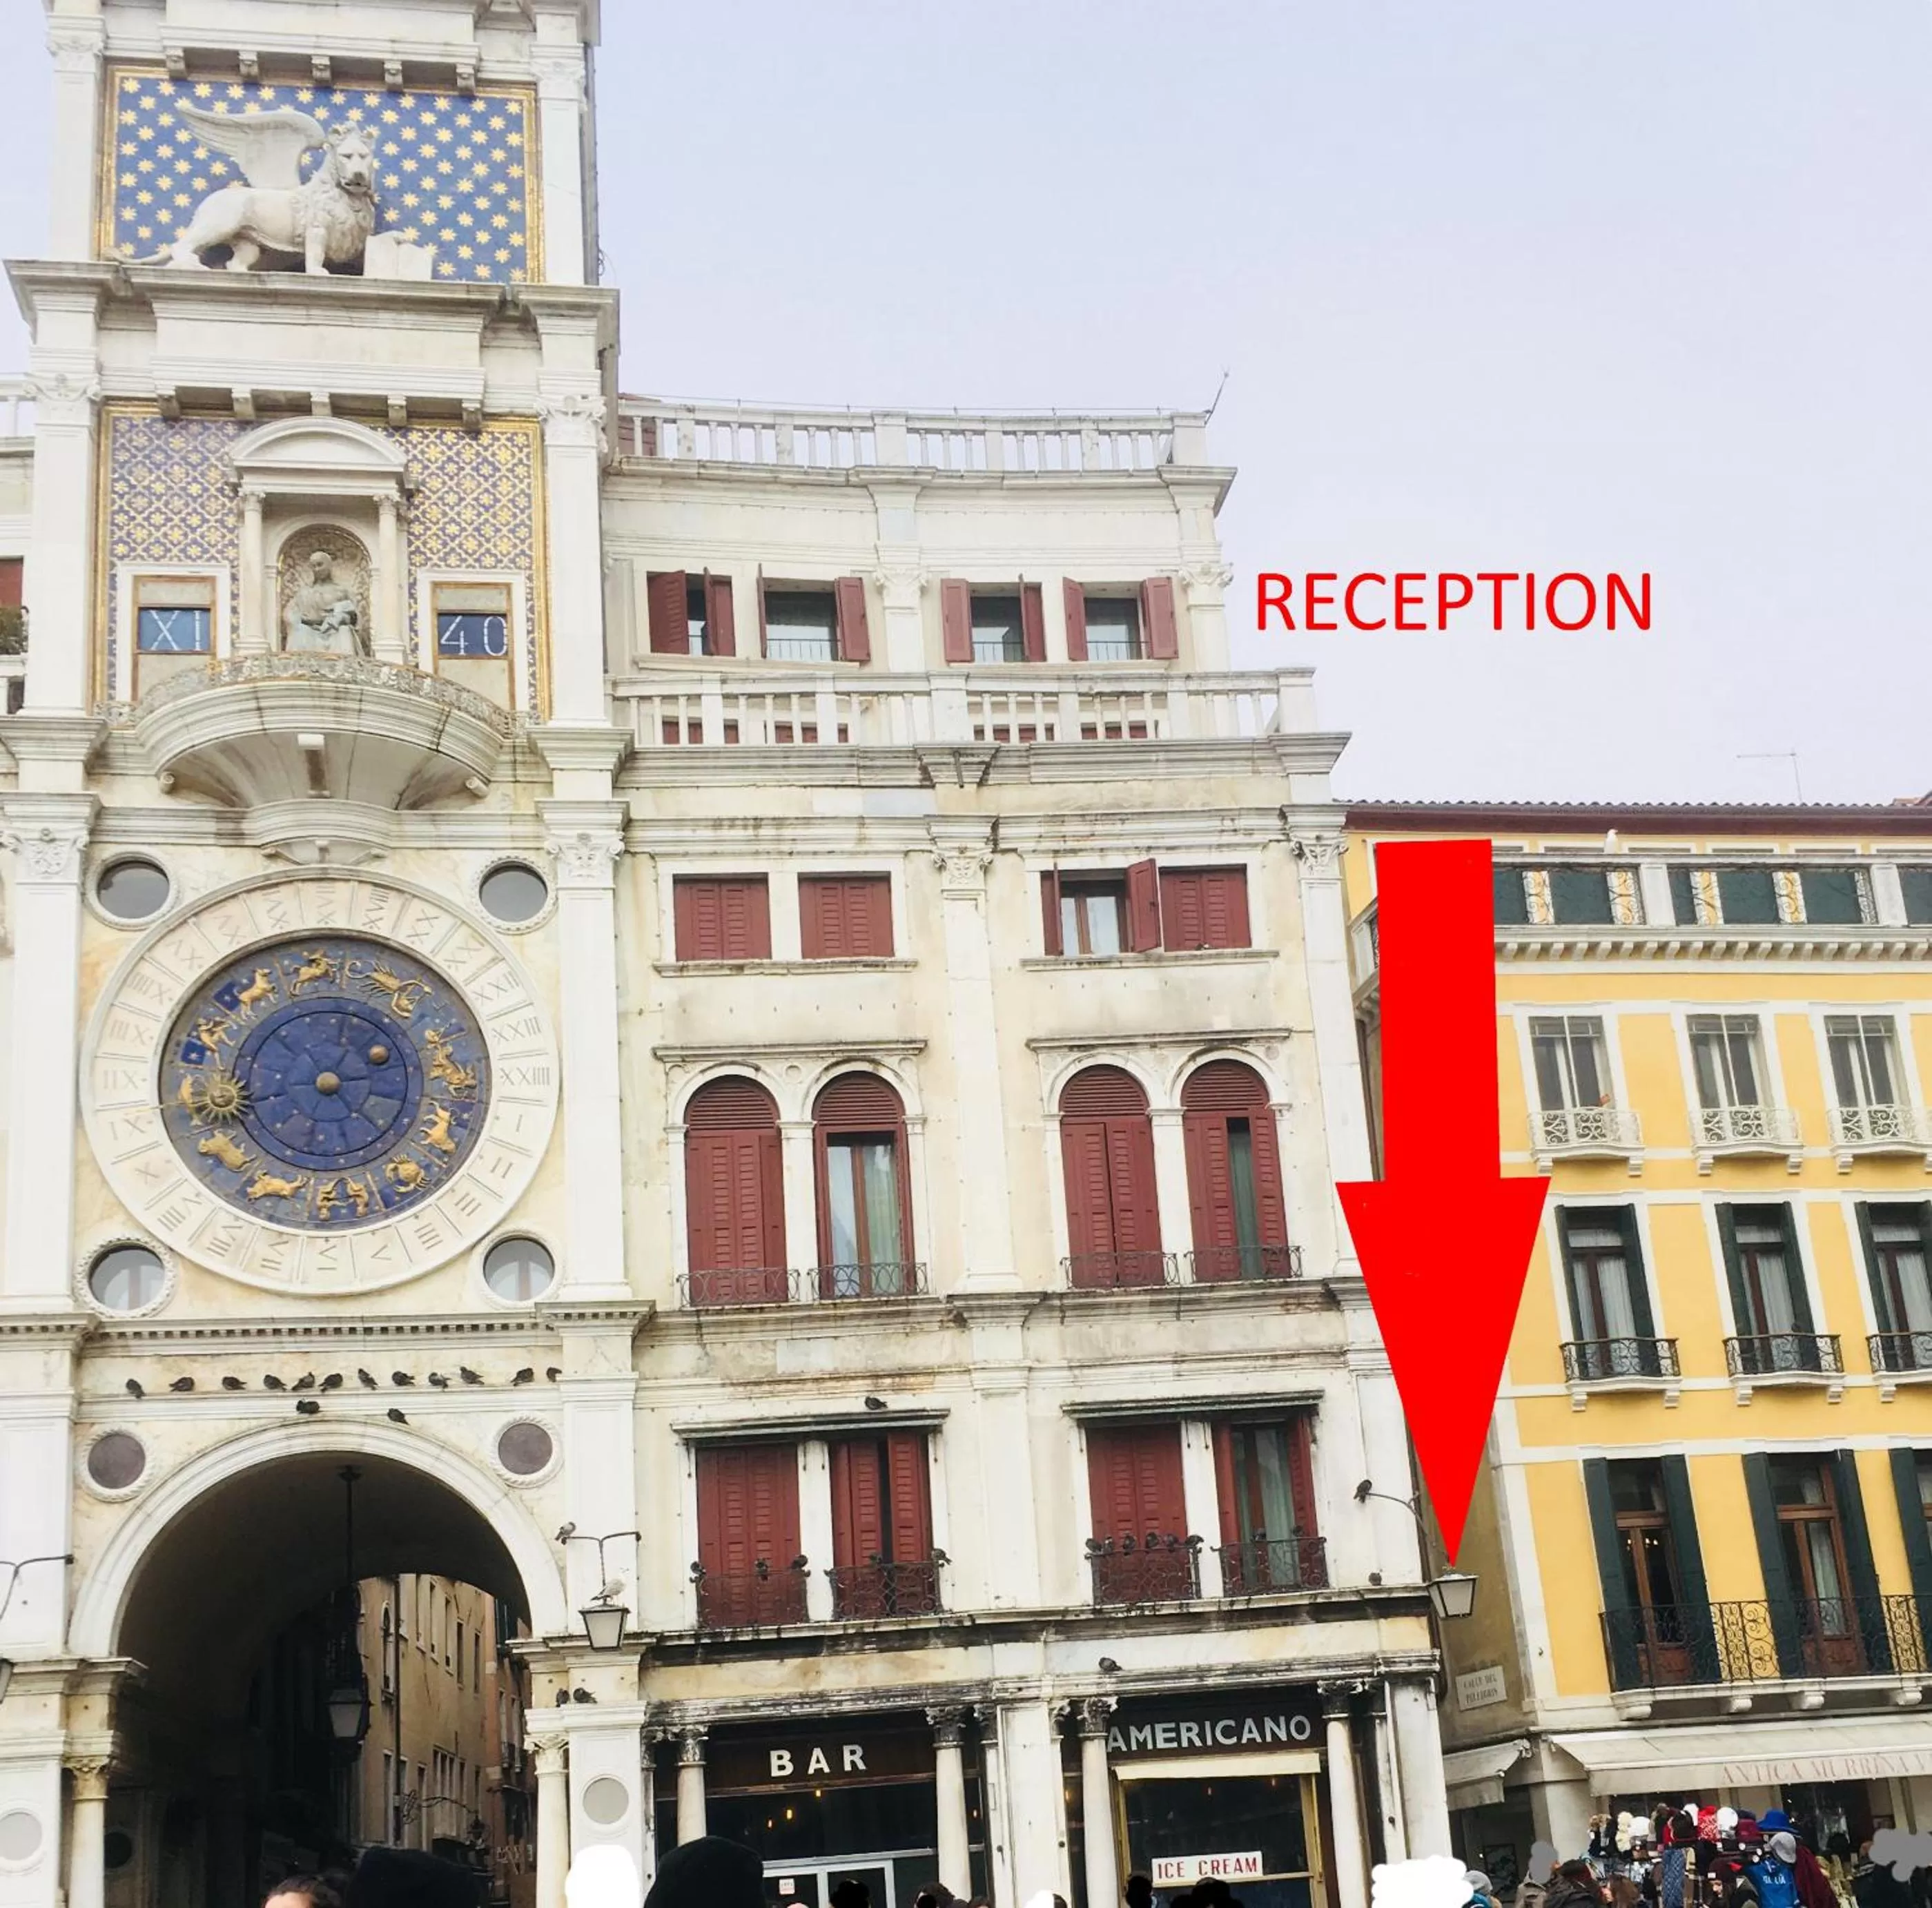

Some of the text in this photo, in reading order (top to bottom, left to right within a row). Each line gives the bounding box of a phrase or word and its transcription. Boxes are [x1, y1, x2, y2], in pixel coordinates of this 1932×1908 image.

[149, 610, 201, 652] XI
[440, 615, 509, 656] 40
[1106, 1714, 1311, 1753] AMERICANO
[770, 1744, 867, 1778] BAR
[1158, 1856, 1258, 1880] ICE CREAM
